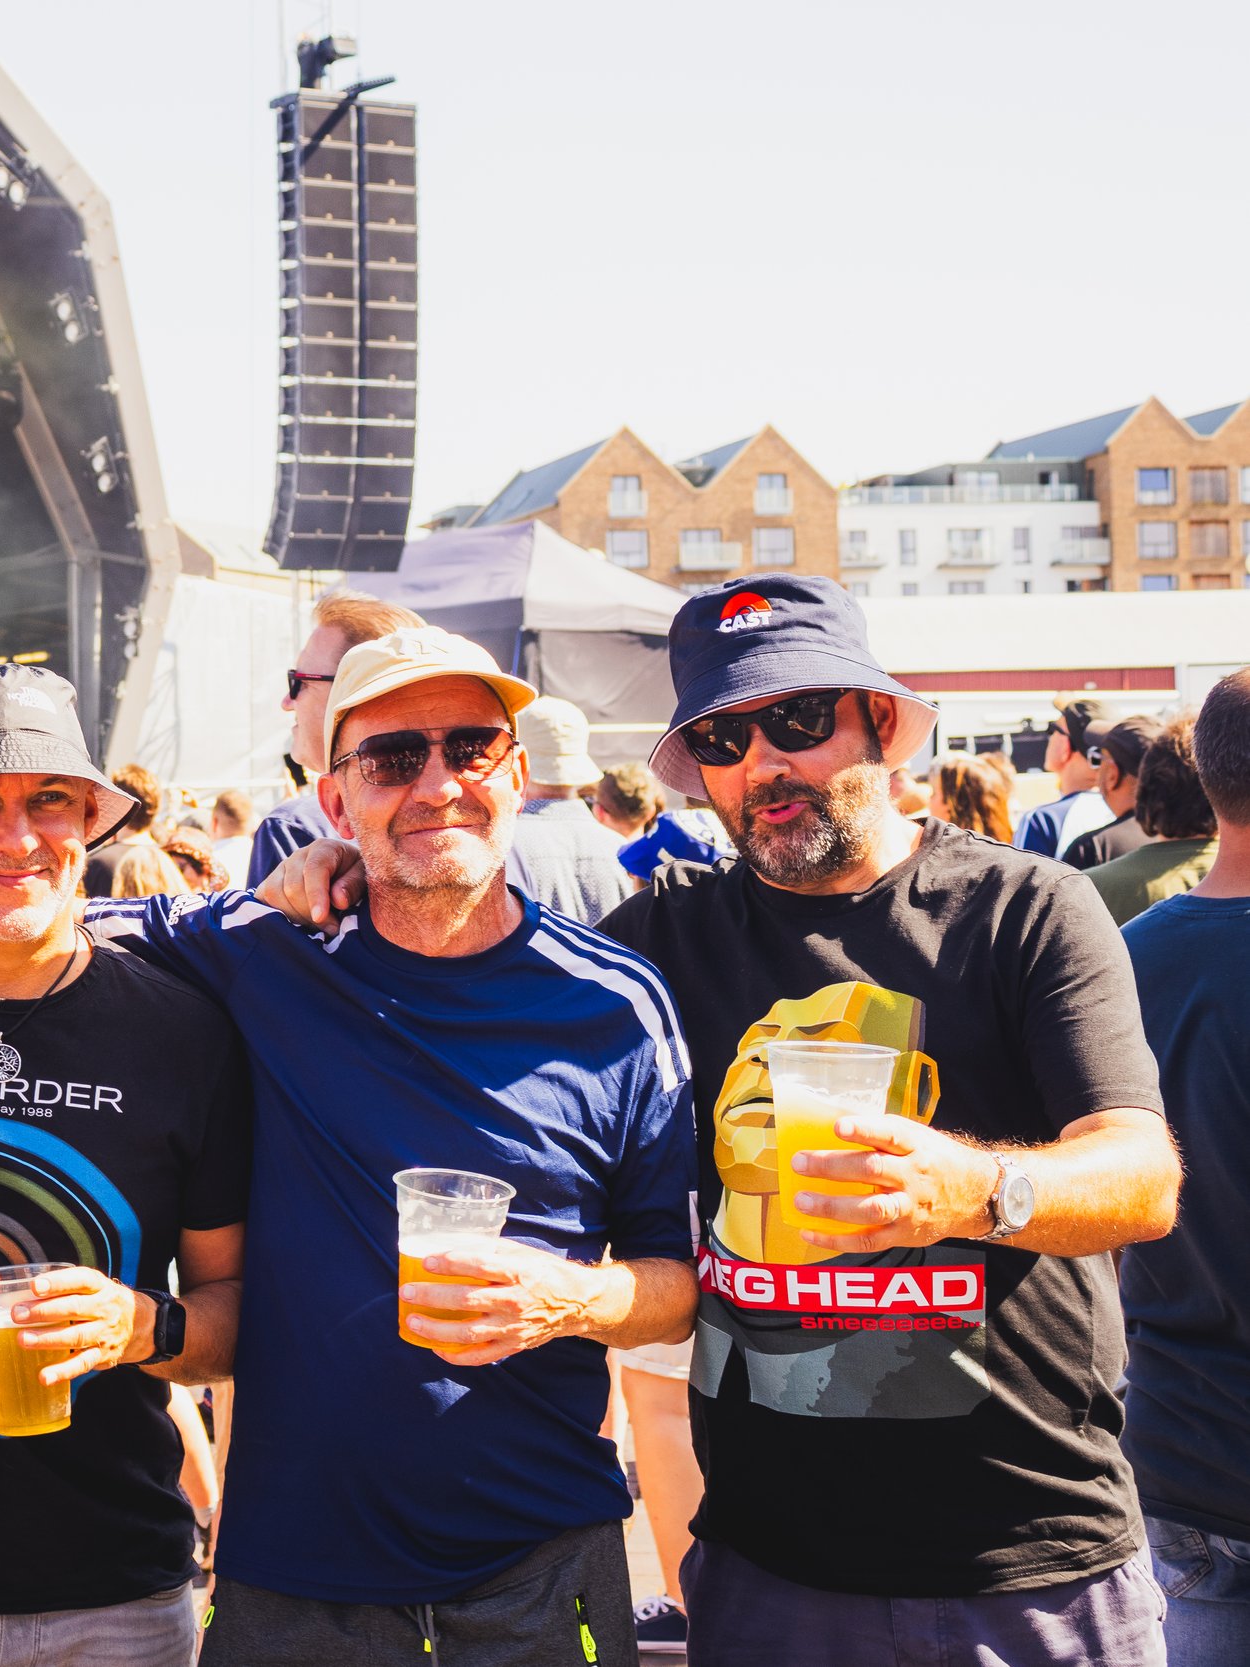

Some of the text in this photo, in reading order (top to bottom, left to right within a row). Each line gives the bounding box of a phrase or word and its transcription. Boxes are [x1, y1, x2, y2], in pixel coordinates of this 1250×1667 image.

[718, 612, 772, 633] CAST
[168, 895, 187, 926] didas
[21, 1107, 53, 1118] 1988
[786, 1270, 978, 1308] HEAD
